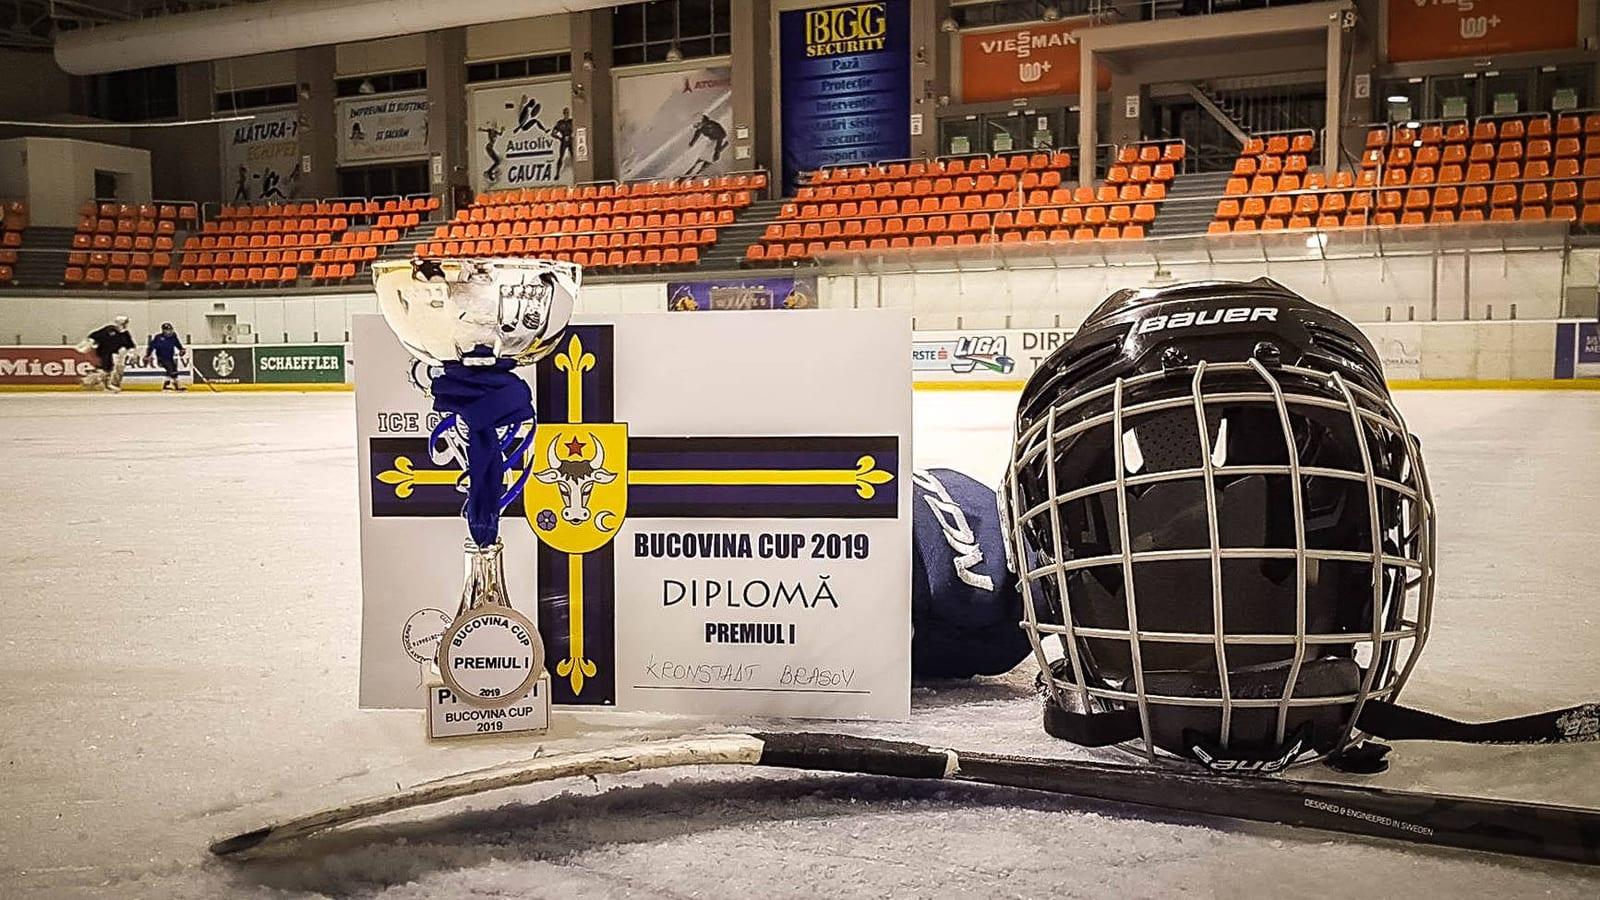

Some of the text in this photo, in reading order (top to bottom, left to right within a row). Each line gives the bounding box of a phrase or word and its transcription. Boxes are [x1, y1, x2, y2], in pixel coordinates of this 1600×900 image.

[806, 3, 887, 45] BGG
[806, 37, 886, 57] SECURITY
[981, 31, 1077, 58] VIESSMAN
[506, 137, 553, 152] Autoliv
[1137, 307, 1278, 335] BAUER
[912, 350, 936, 360] RSTE
[954, 336, 1007, 357] LIGA
[0, 359, 98, 377] Miele
[260, 356, 339, 370] SCHAEFFLER
[378, 412, 419, 432] ICE
[634, 533, 869, 559] BUCOVINA CUP 2019
[663, 575, 838, 608] DIPLOMĂ
[453, 616, 530, 647] BUCOVINA CUP
[705, 622, 796, 644] PREMIUL I
[454, 656, 529, 669] PREMIUL I
[779, 664, 855, 686] BRASOV
[479, 688, 500, 697] 2019
[445, 706, 533, 722] BUCOVINA CUP
[477, 721, 503, 732] 2019
[1304, 799, 1339, 813] DESIGNED
[1346, 808, 1392, 827] ENGINEERED
[1392, 819, 1400, 829] IN
[1400, 822, 1434, 836] SWEDEN
